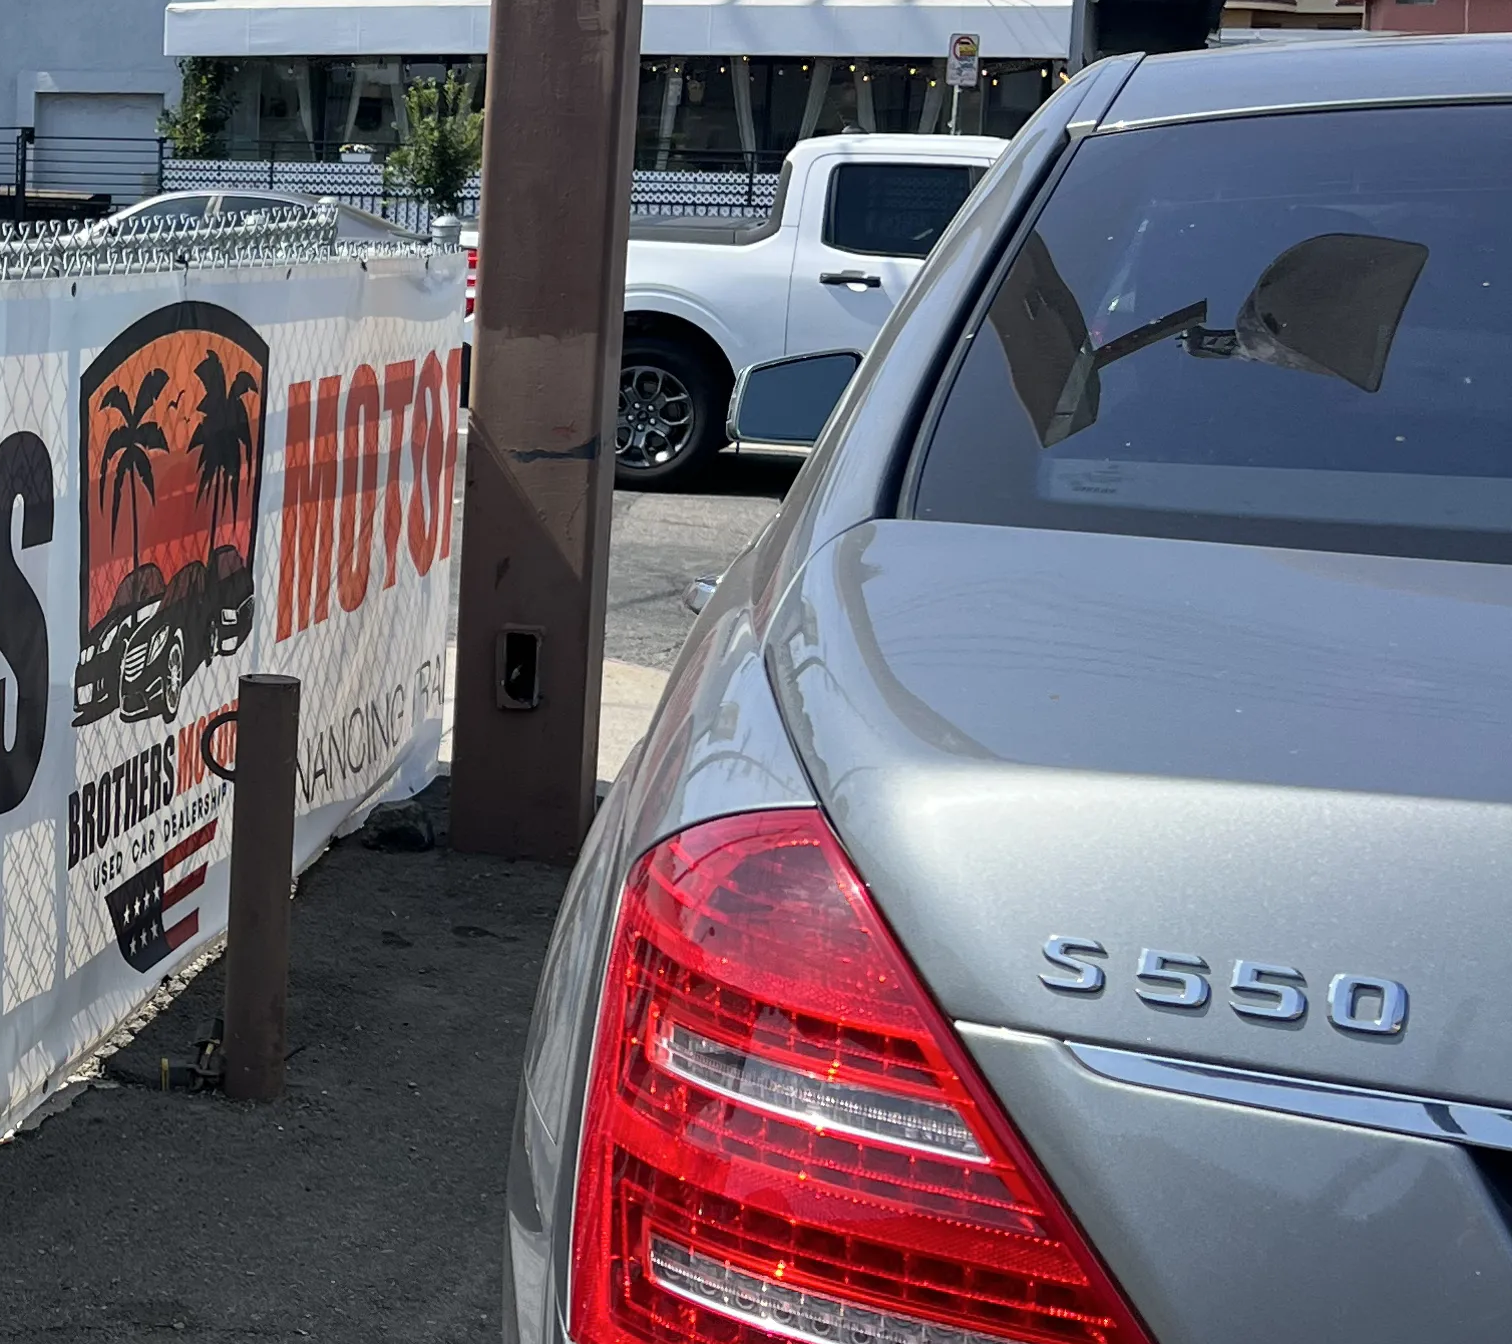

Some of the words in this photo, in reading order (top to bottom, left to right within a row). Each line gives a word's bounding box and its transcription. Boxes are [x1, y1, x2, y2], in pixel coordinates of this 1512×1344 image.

[68, 735, 175, 871] BROTHERS
[93, 852, 123, 891] USED
[132, 829, 155, 864] CAR
[163, 782, 227, 843] DEALERSHIP
